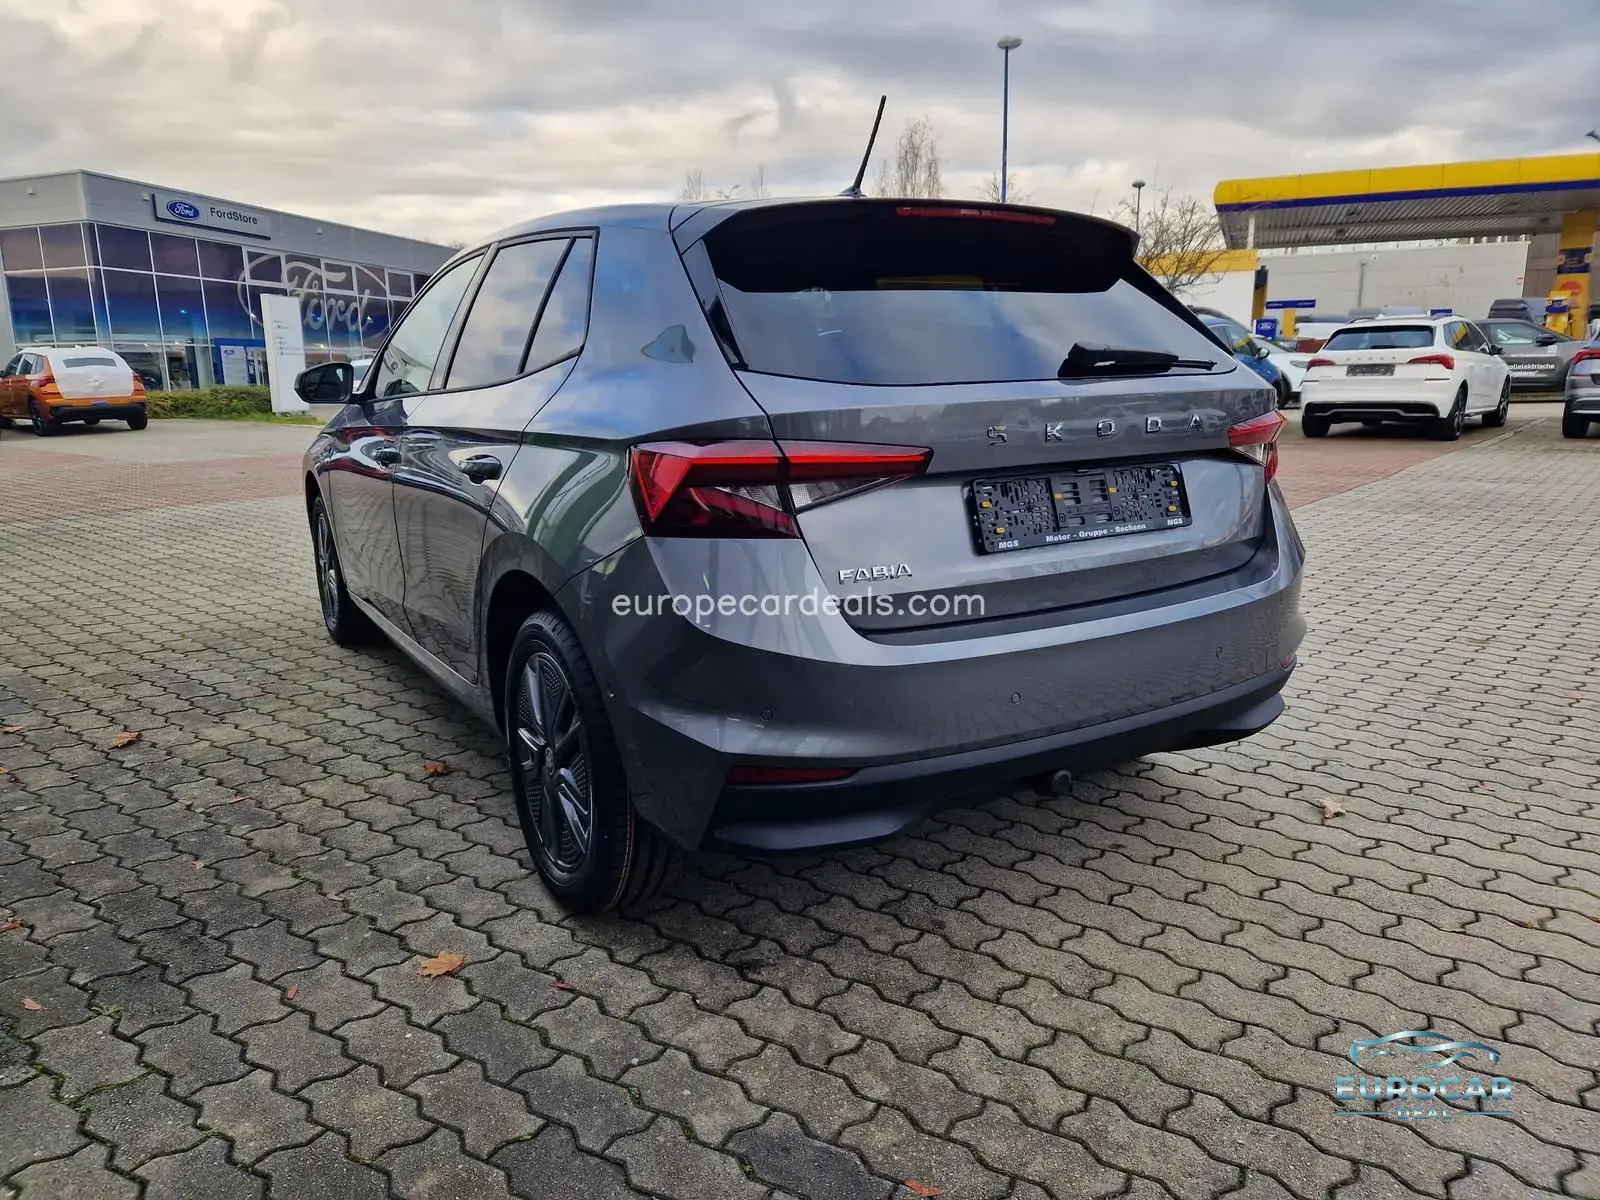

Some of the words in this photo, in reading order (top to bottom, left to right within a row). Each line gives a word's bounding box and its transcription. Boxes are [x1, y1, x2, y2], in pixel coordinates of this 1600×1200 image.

[209, 207, 259, 225] FordStore
[286, 260, 374, 331] Ford
[986, 413, 1205, 447] SKODA
[1166, 517, 1183, 526] MGS
[1046, 533, 1070, 543] Motor
[1078, 528, 1108, 540] Gruppe
[1115, 523, 1147, 533] Sachsen
[998, 540, 1019, 550] MGS
[838, 563, 913, 585] FABIA
